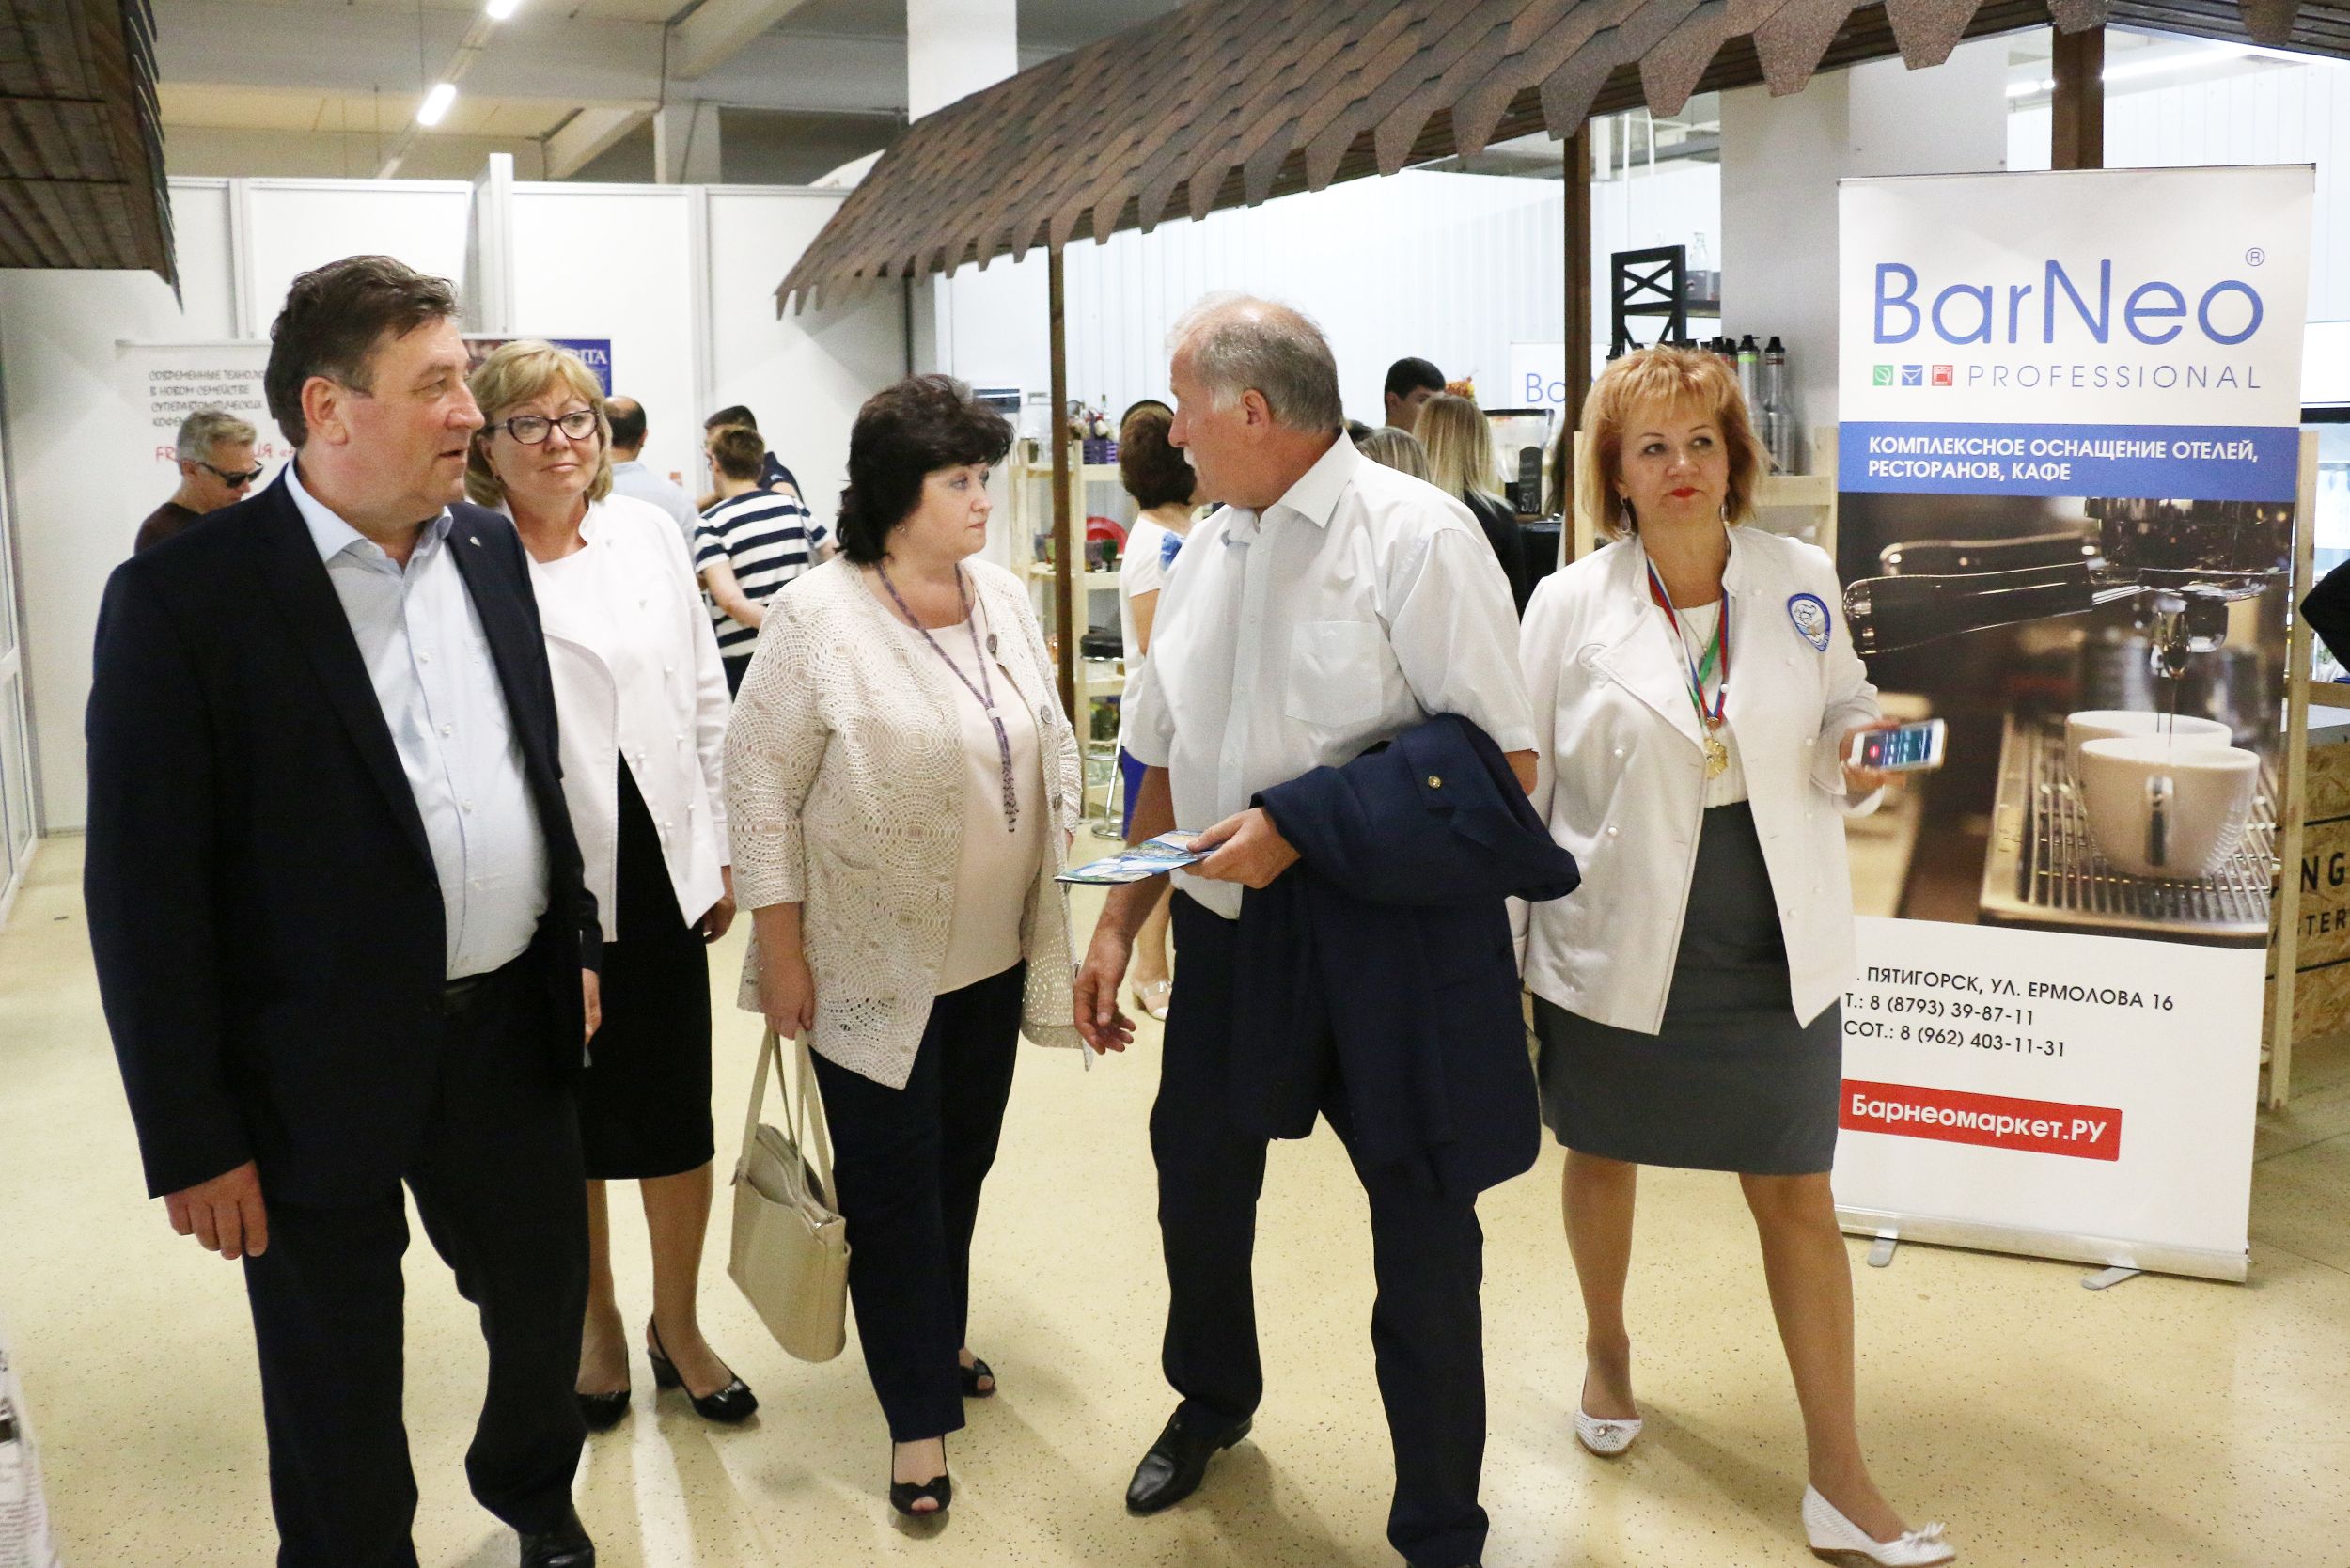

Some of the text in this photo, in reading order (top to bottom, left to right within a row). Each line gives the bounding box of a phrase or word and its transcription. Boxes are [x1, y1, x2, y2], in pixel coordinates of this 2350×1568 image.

[1873, 259, 2264, 346] BarNeo
[1968, 364, 2261, 389] PROFESSIONAL
[1869, 436, 2259, 463] КОМПЛЕКСНОЕ ОСНАЩЕНИЕ ОТЕЛЕЙ,
[1868, 460, 2071, 481] РЕСТОРАНОВ, КАФЕ
[1867, 966, 2173, 1011] ПЯТИГОРСК, УЛ. ЕРМОЛОВА 16
[1870, 995, 1880, 1011] 8
[1888, 996, 1945, 1018] (8793)
[1950, 1002, 2033, 1026] 39-87-11
[1844, 1020, 2064, 1057] СОТ.: 8 (962) 403-11-31
[1851, 1093, 2107, 1144] Барнеомаркет.РУ
